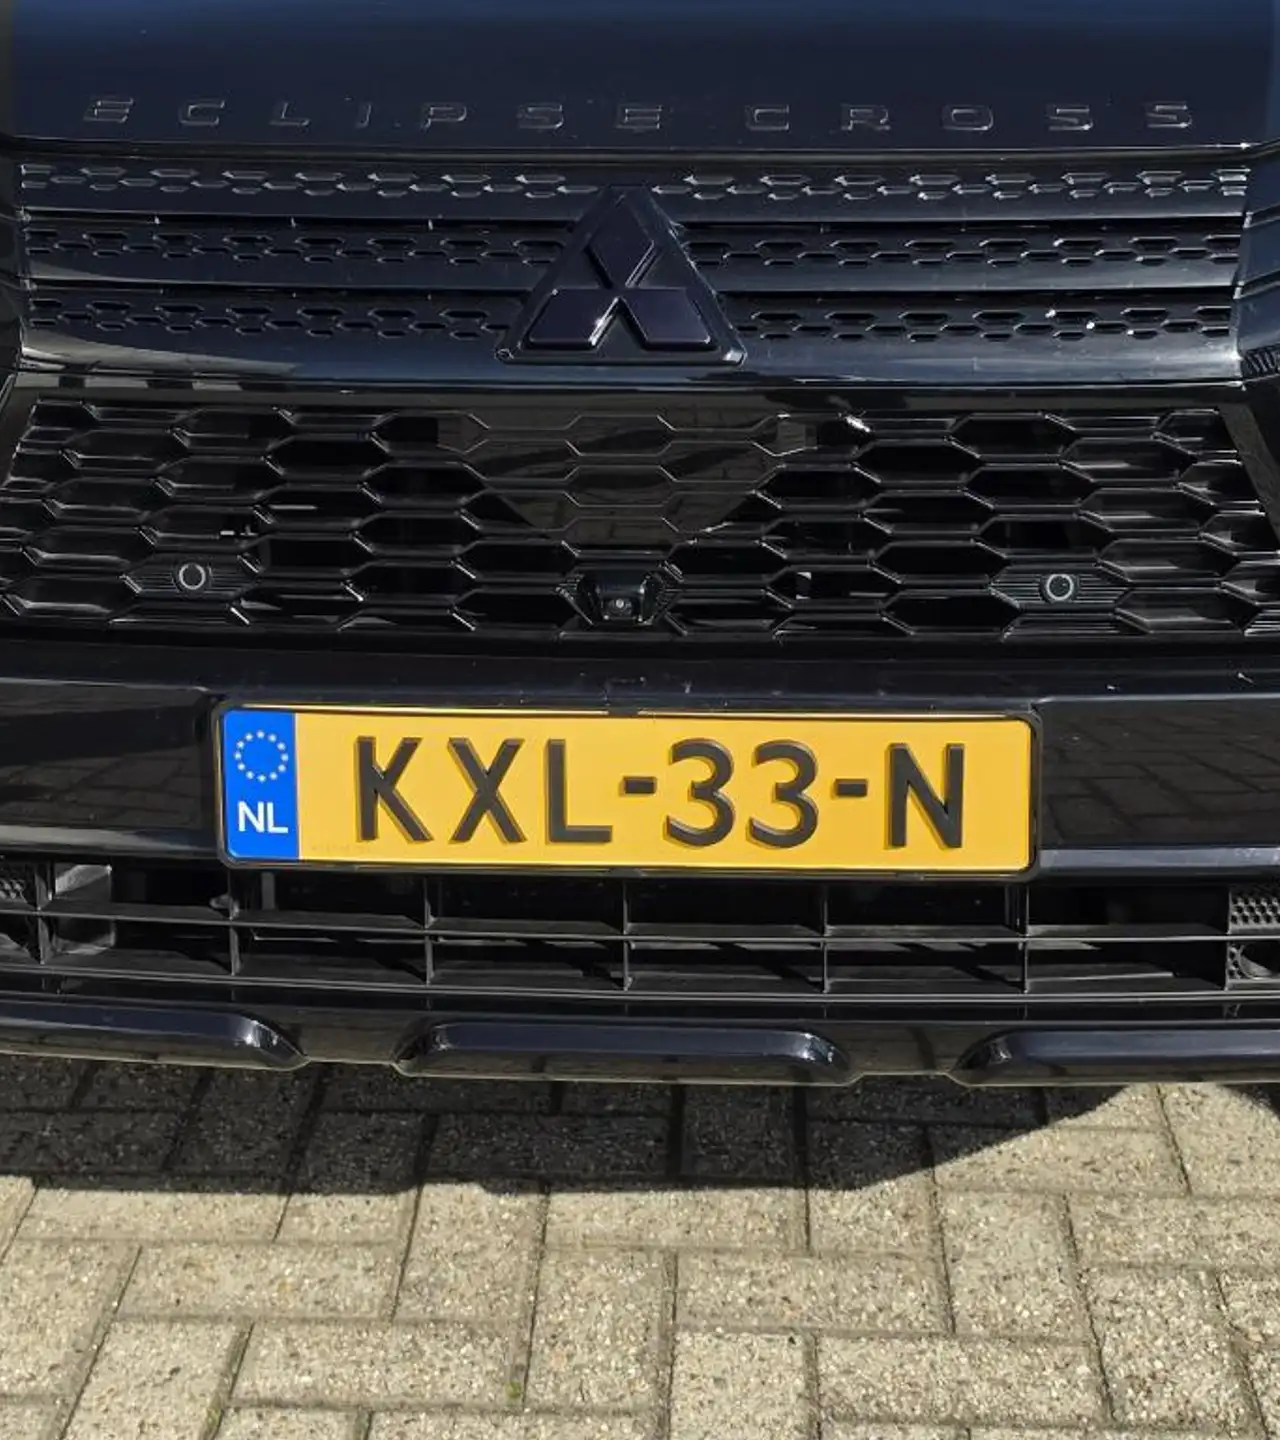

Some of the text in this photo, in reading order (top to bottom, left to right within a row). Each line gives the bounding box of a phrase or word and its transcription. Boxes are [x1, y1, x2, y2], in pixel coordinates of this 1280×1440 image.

[82, 97, 1195, 133] ECLIPSE CROSS
[237, 733, 967, 851] NL KXL-33-N
